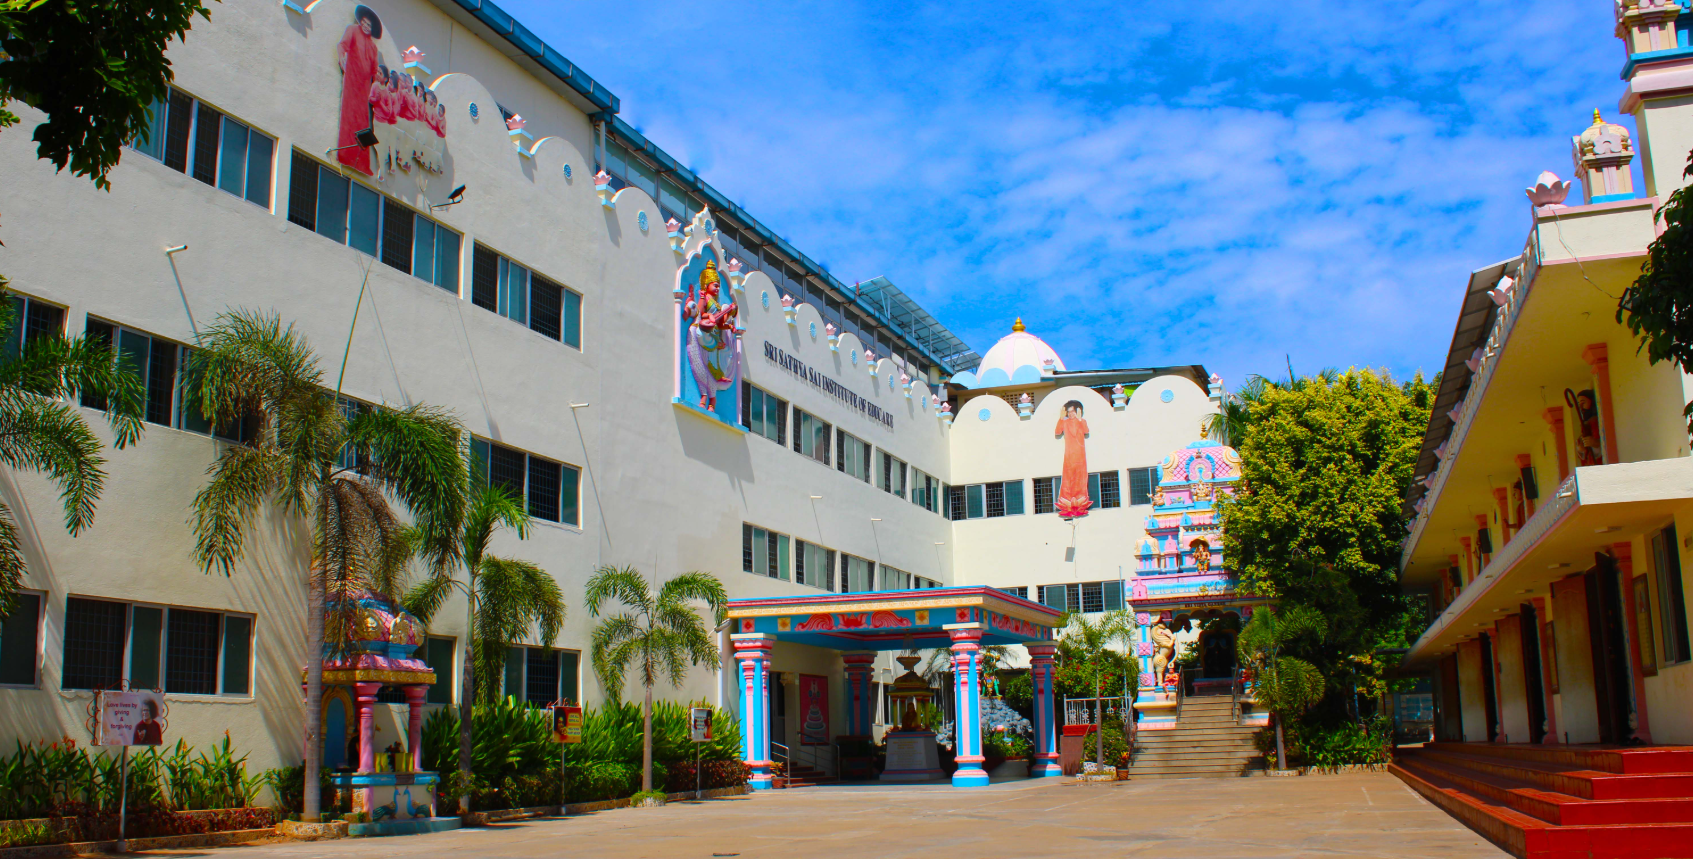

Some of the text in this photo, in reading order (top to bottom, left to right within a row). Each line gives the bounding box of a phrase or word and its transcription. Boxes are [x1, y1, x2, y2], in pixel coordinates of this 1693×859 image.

[764, 340, 894, 428] SRI SATHYA SAI INSTITUTE OF EDUCARE
